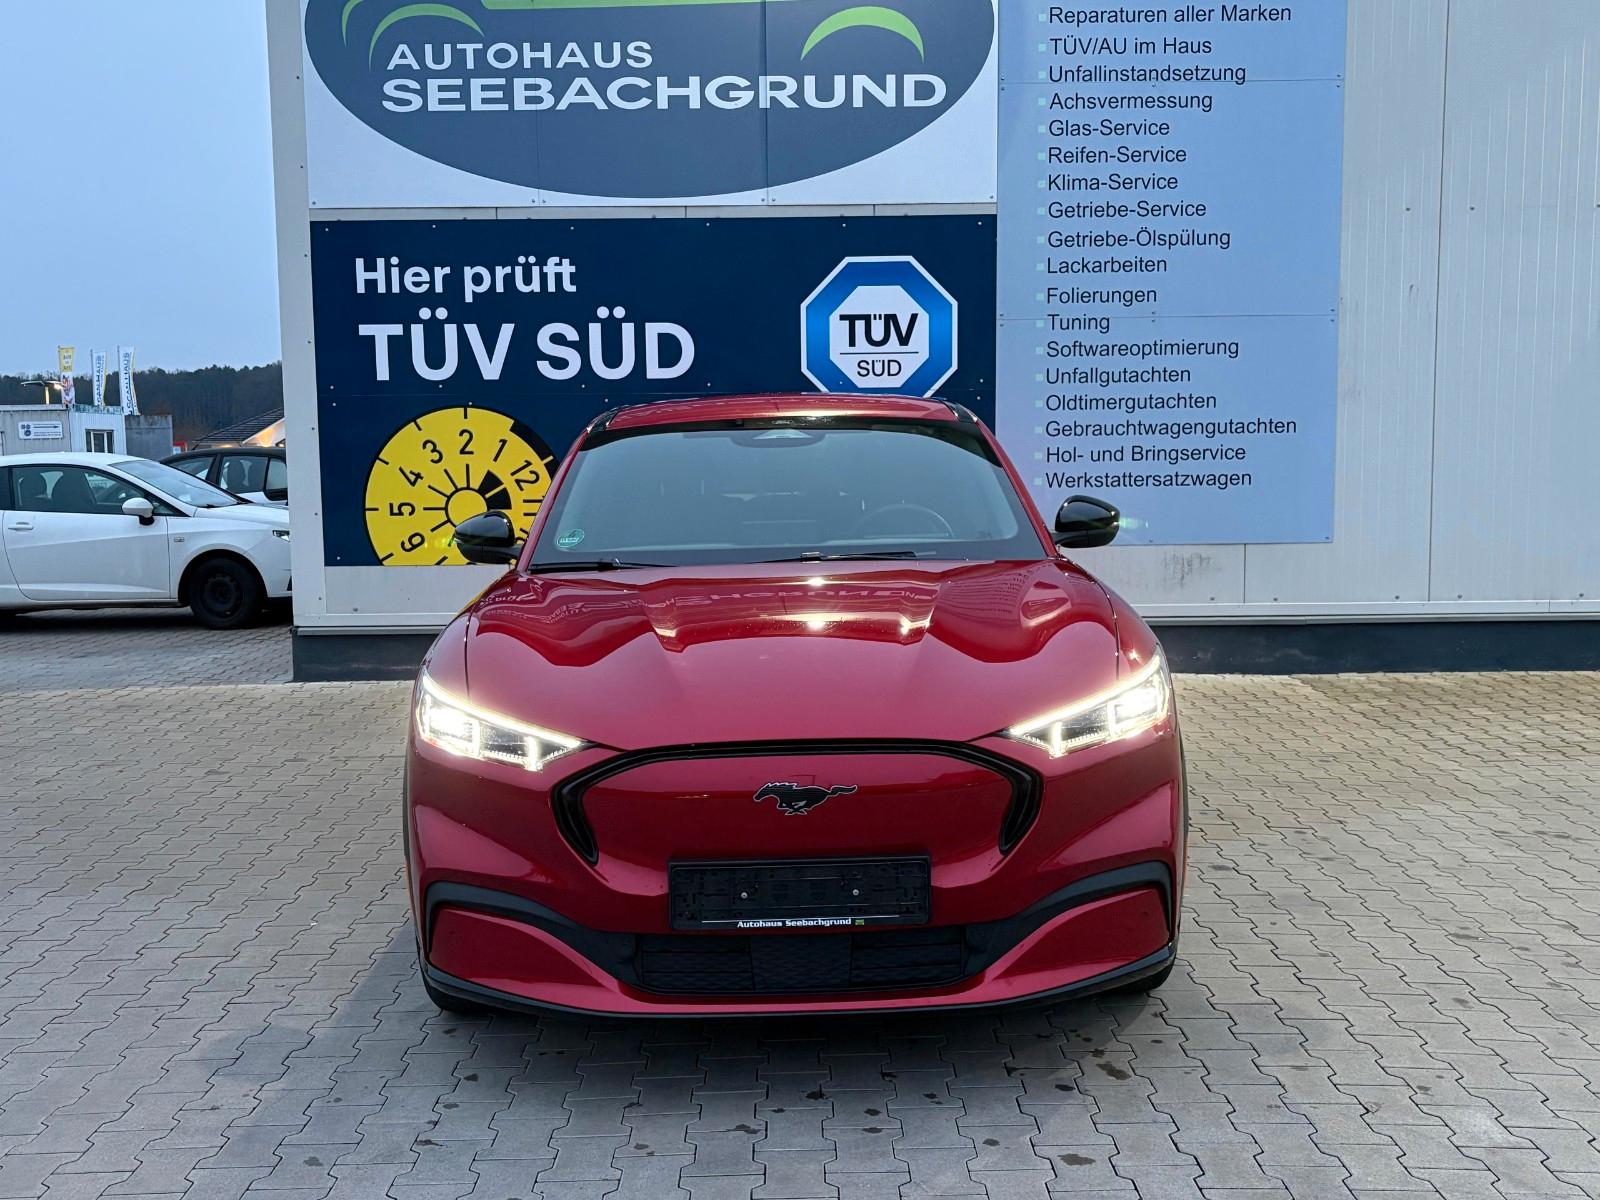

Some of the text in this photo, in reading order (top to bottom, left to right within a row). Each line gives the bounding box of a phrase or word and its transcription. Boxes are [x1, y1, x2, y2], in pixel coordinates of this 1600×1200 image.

[1049, 3, 1291, 28] Reparaturen aller Marken
[386, 40, 653, 70] AUTOHAUS
[1049, 34, 1212, 55] TÜV/AU im Haus
[1049, 64, 1246, 86] Unfallinstandsetzung
[382, 74, 947, 112] SEEBACHGRUND
[1049, 92, 1213, 113] Achsvermessung
[1048, 118, 1170, 137] Glas-Service
[1048, 145, 1187, 164] Reifen-Service
[1048, 172, 1178, 191] Klima-Service
[1048, 199, 1207, 219] Getriebe-Service
[1047, 226, 1231, 249] Getriebe-Ölspülung
[1047, 255, 1167, 274] Lackarbeiten
[355, 255, 577, 303] Hier prüft
[1047, 287, 1157, 308] Folierungen
[839, 312, 919, 348] TÜV
[1047, 313, 1111, 334] Tuning
[358, 305, 695, 381] TÜV SÜD
[1046, 338, 1239, 360] Softwareoptimierung
[856, 359, 902, 378] SÜD
[1046, 366, 1191, 388] Unfallgutachten
[1045, 392, 1217, 414] Oldtimergutachten
[1045, 417, 1297, 440] Gebrauchtwagengutachten
[422, 439, 444, 465] 3
[458, 428, 475, 455] 2
[492, 438, 508, 463] 1
[1046, 443, 1246, 465] Hol- und Bringservice
[398, 466, 424, 488] 4
[510, 459, 540, 492] 12
[1045, 471, 1252, 490] Werkstattersatzwagen
[388, 502, 416, 517] 5
[400, 532, 426, 553] 6
[736, 918, 852, 928] Autohaus Seebachgrund
